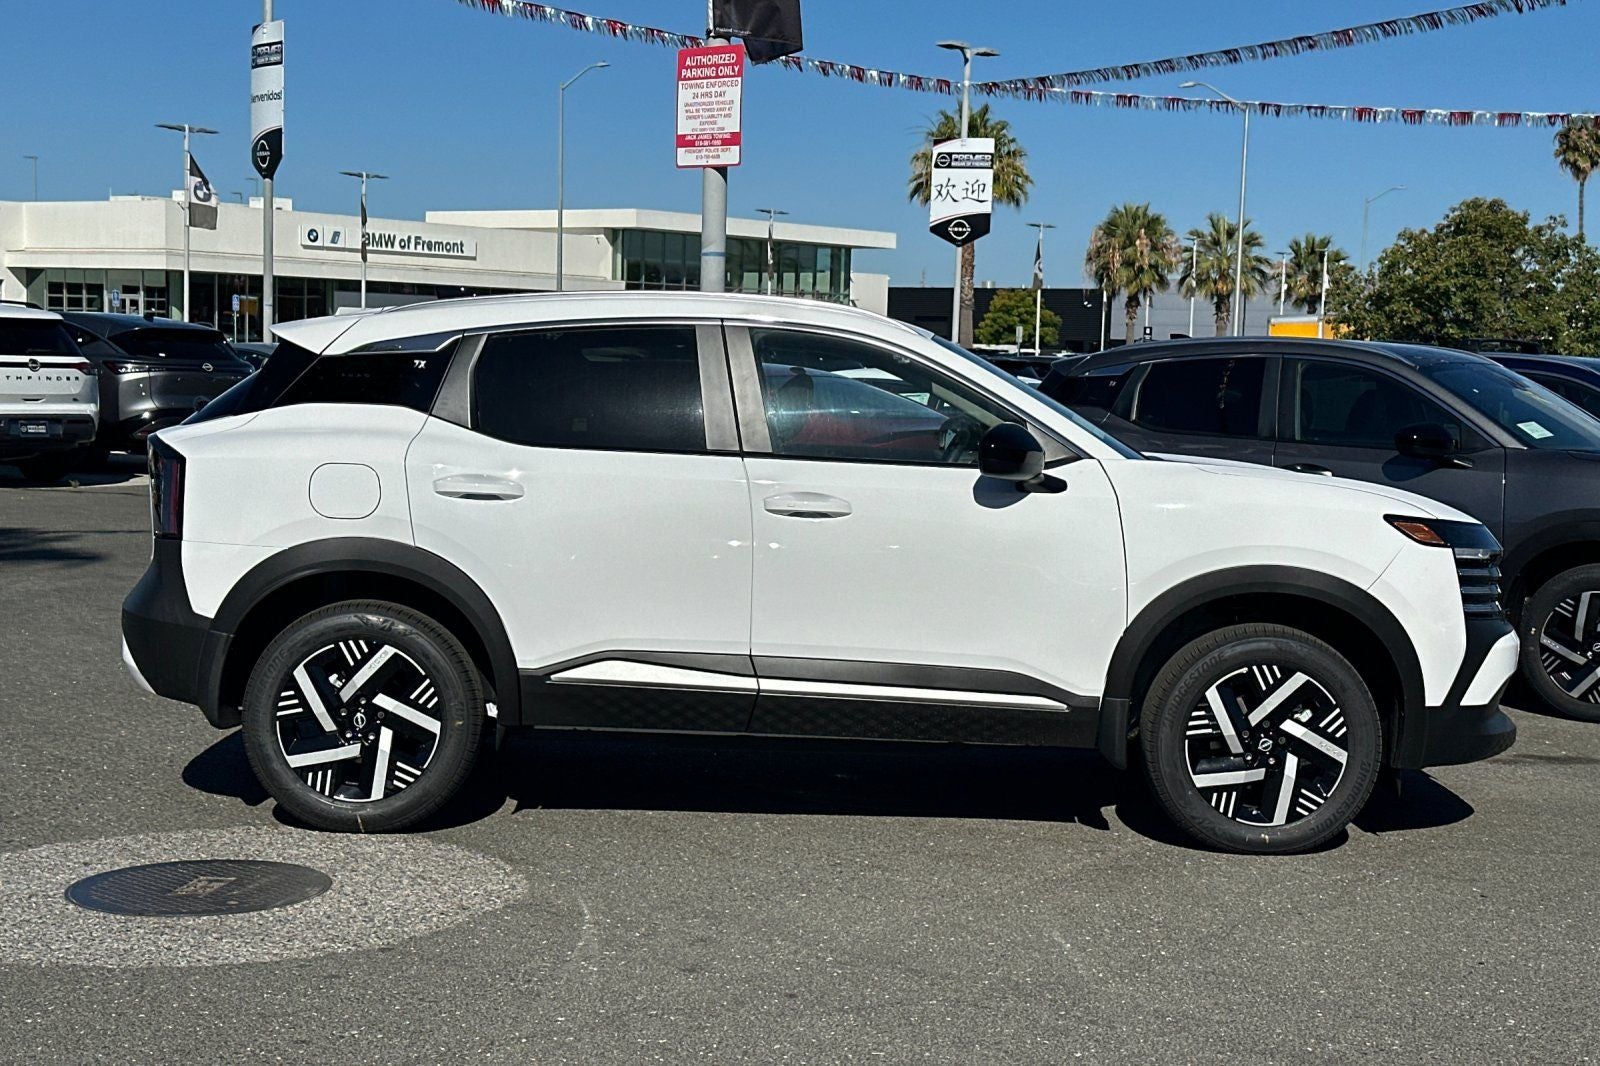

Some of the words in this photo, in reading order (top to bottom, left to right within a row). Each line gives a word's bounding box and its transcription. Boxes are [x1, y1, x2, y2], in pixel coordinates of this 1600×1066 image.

[685, 53, 737, 67] AUTHORIZED
[681, 67, 716, 79] PARKING
[718, 65, 740, 77] ONLY
[681, 81, 705, 91] TOWING
[705, 79, 739, 89] ENFORCED
[692, 92, 699, 100] 24
[700, 91, 713, 99] HRS
[714, 90, 727, 98] DAY
[934, 177, 989, 203] 欢迎
[399, 234, 412, 250] of
[414, 235, 465, 254] Fremont
